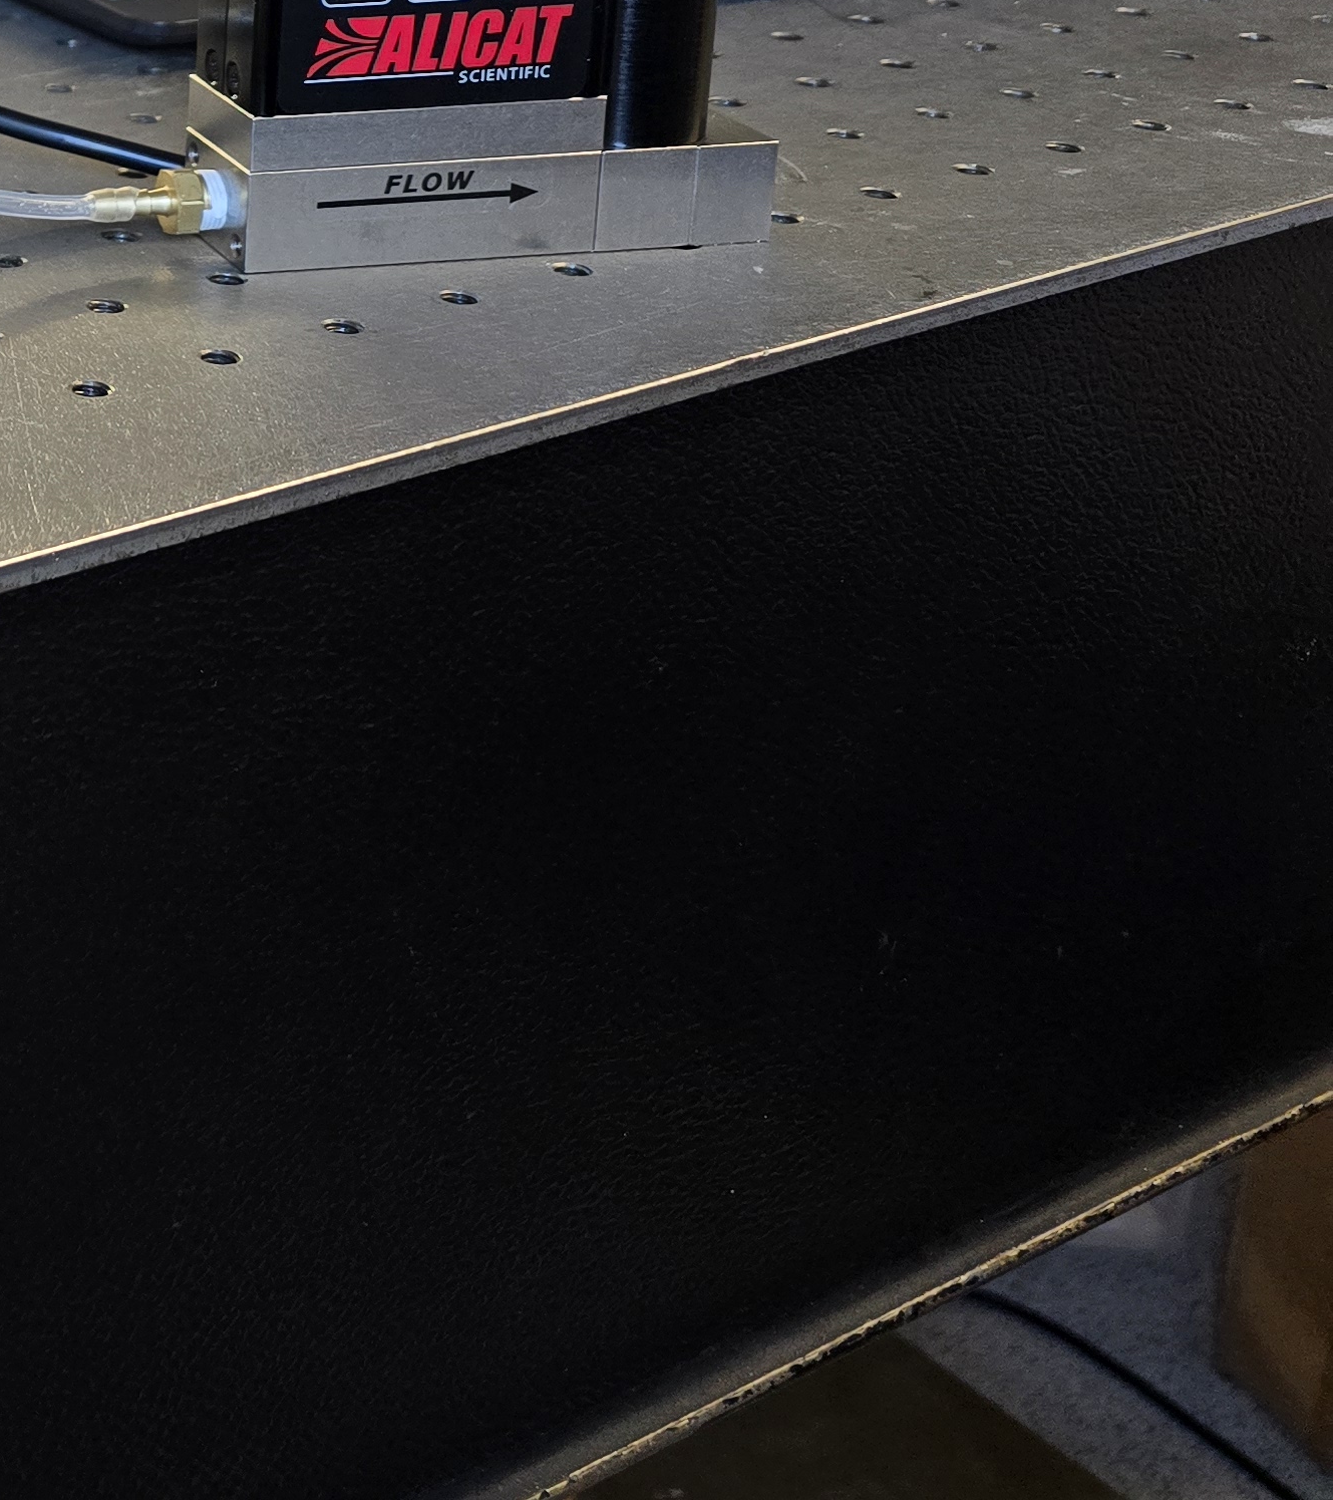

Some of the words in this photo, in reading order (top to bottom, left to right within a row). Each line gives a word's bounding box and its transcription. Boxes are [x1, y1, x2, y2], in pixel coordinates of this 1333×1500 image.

[370, 3, 575, 74] ALICAT
[458, 64, 552, 84] SCIENTIFIC
[383, 170, 475, 195] FLOW
